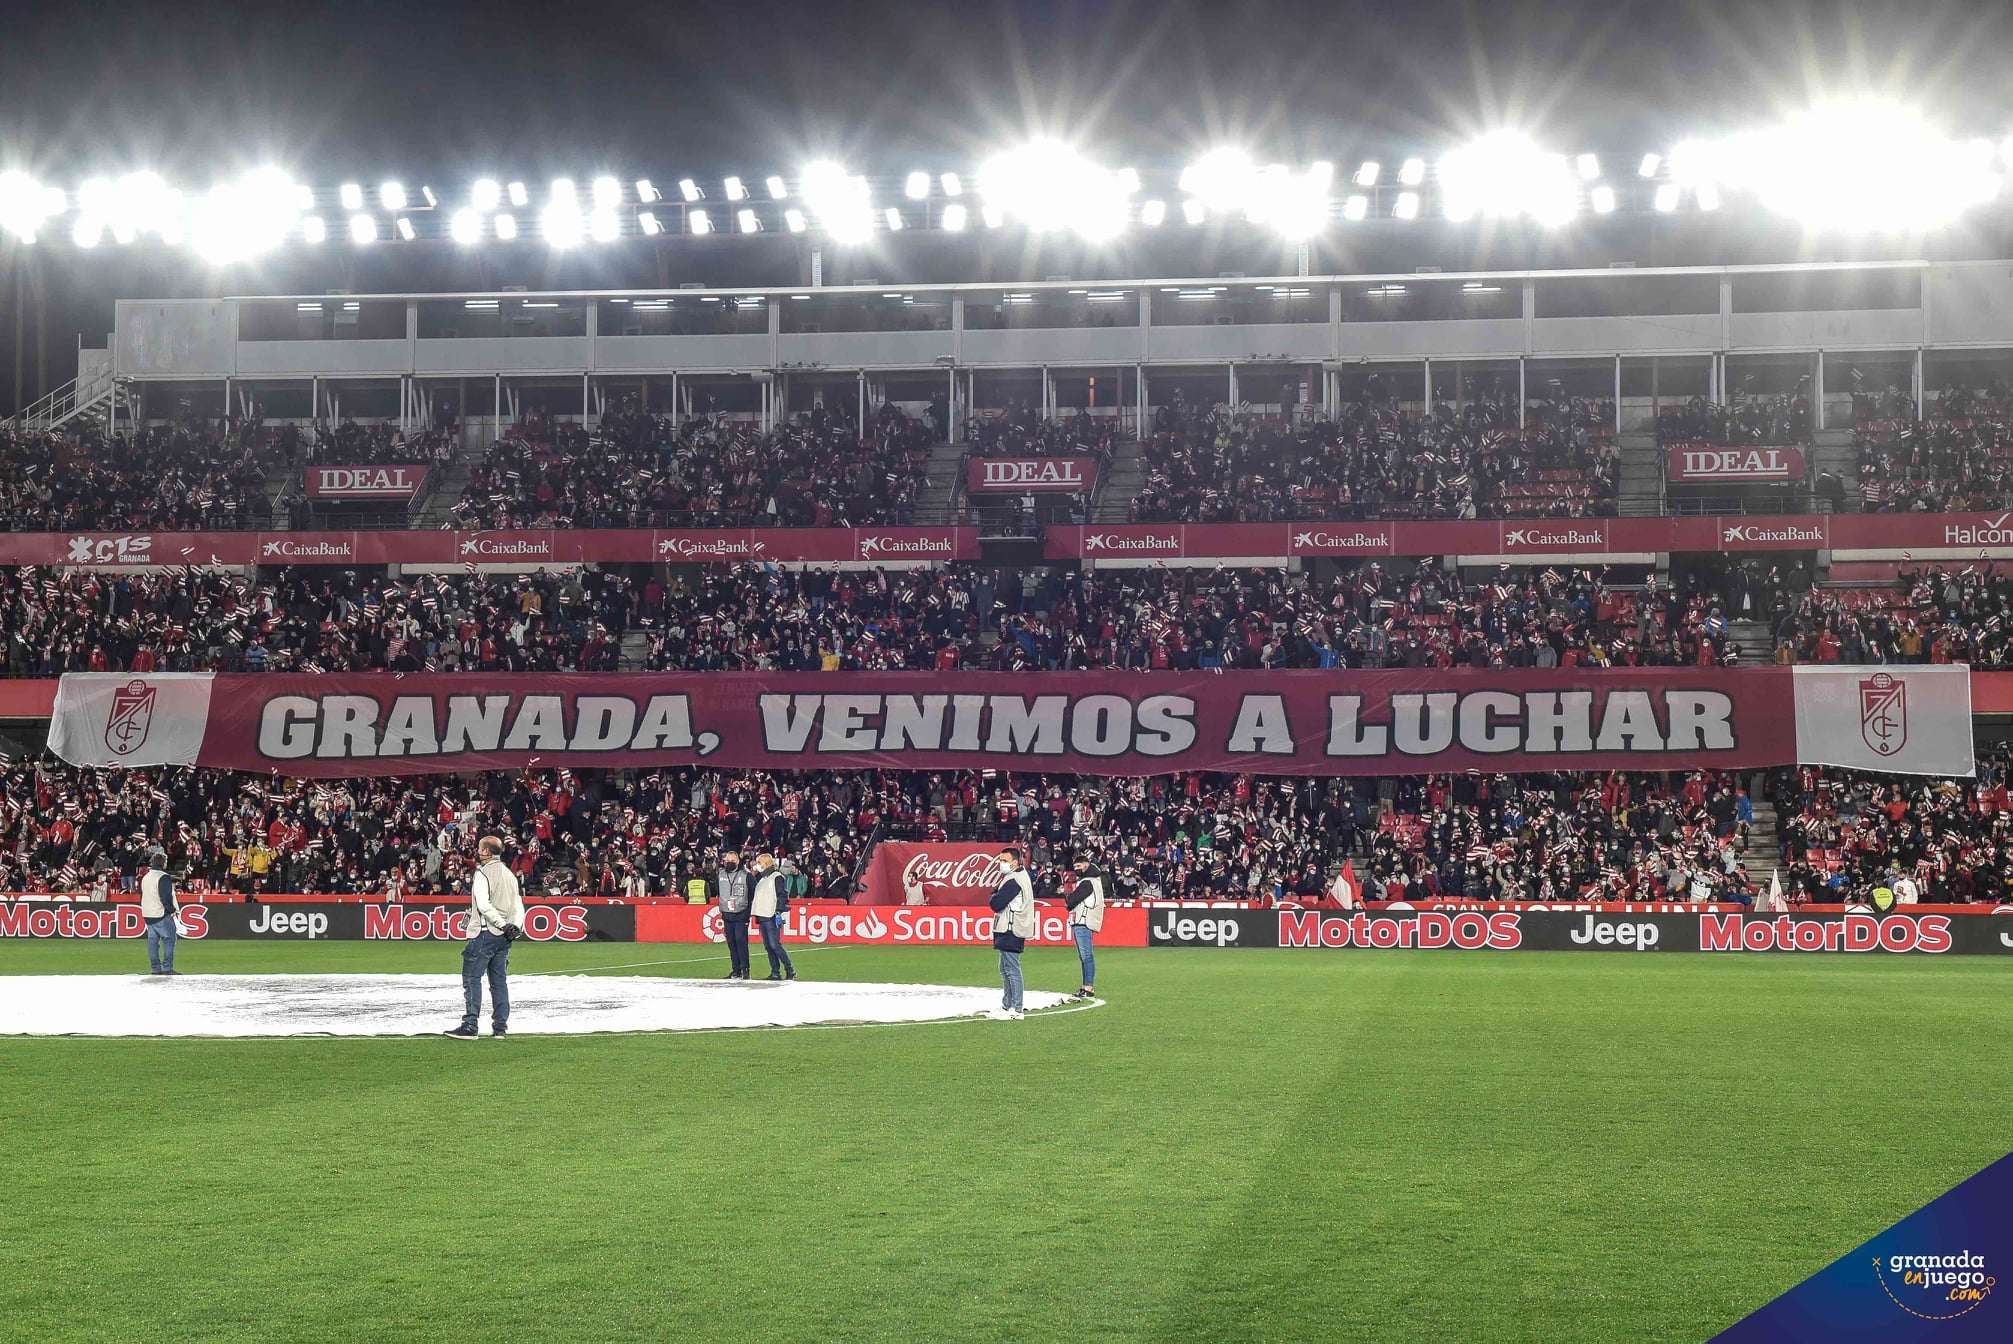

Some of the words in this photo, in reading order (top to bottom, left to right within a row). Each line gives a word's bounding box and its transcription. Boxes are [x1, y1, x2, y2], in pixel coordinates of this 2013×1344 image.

[983, 461, 1082, 482] IDEAL
[1682, 450, 1788, 472] IDEAL
[318, 468, 413, 490] IDEAL
[880, 537, 952, 551] CaixaBank
[1105, 535, 1179, 549] CaixaBank
[1314, 532, 1389, 548] CaixaBank
[1525, 530, 1603, 545] CaixaBank
[1745, 526, 1824, 542] CaixaBank
[281, 541, 351, 556] CaixaBank
[479, 539, 549, 554] CaixaBank
[678, 539, 750, 553] CaixaBank
[119, 554, 150, 562] GRANADA
[258, 694, 720, 759] GRANADA,
[760, 694, 1196, 756] VENIMOS
[1227, 695, 1295, 754] A
[1326, 690, 1736, 756] LUCHAR
[903, 853, 1002, 889] Coca-Cola
[0, 903, 208, 939] MotorDS
[248, 905, 328, 939] Jeep
[363, 904, 588, 941] MotoOS
[1153, 911, 1239, 947] Jeep
[1278, 910, 1522, 950] MotorDOS
[1570, 914, 1659, 951] Jeep
[1700, 913, 1953, 953] MotorDOS
